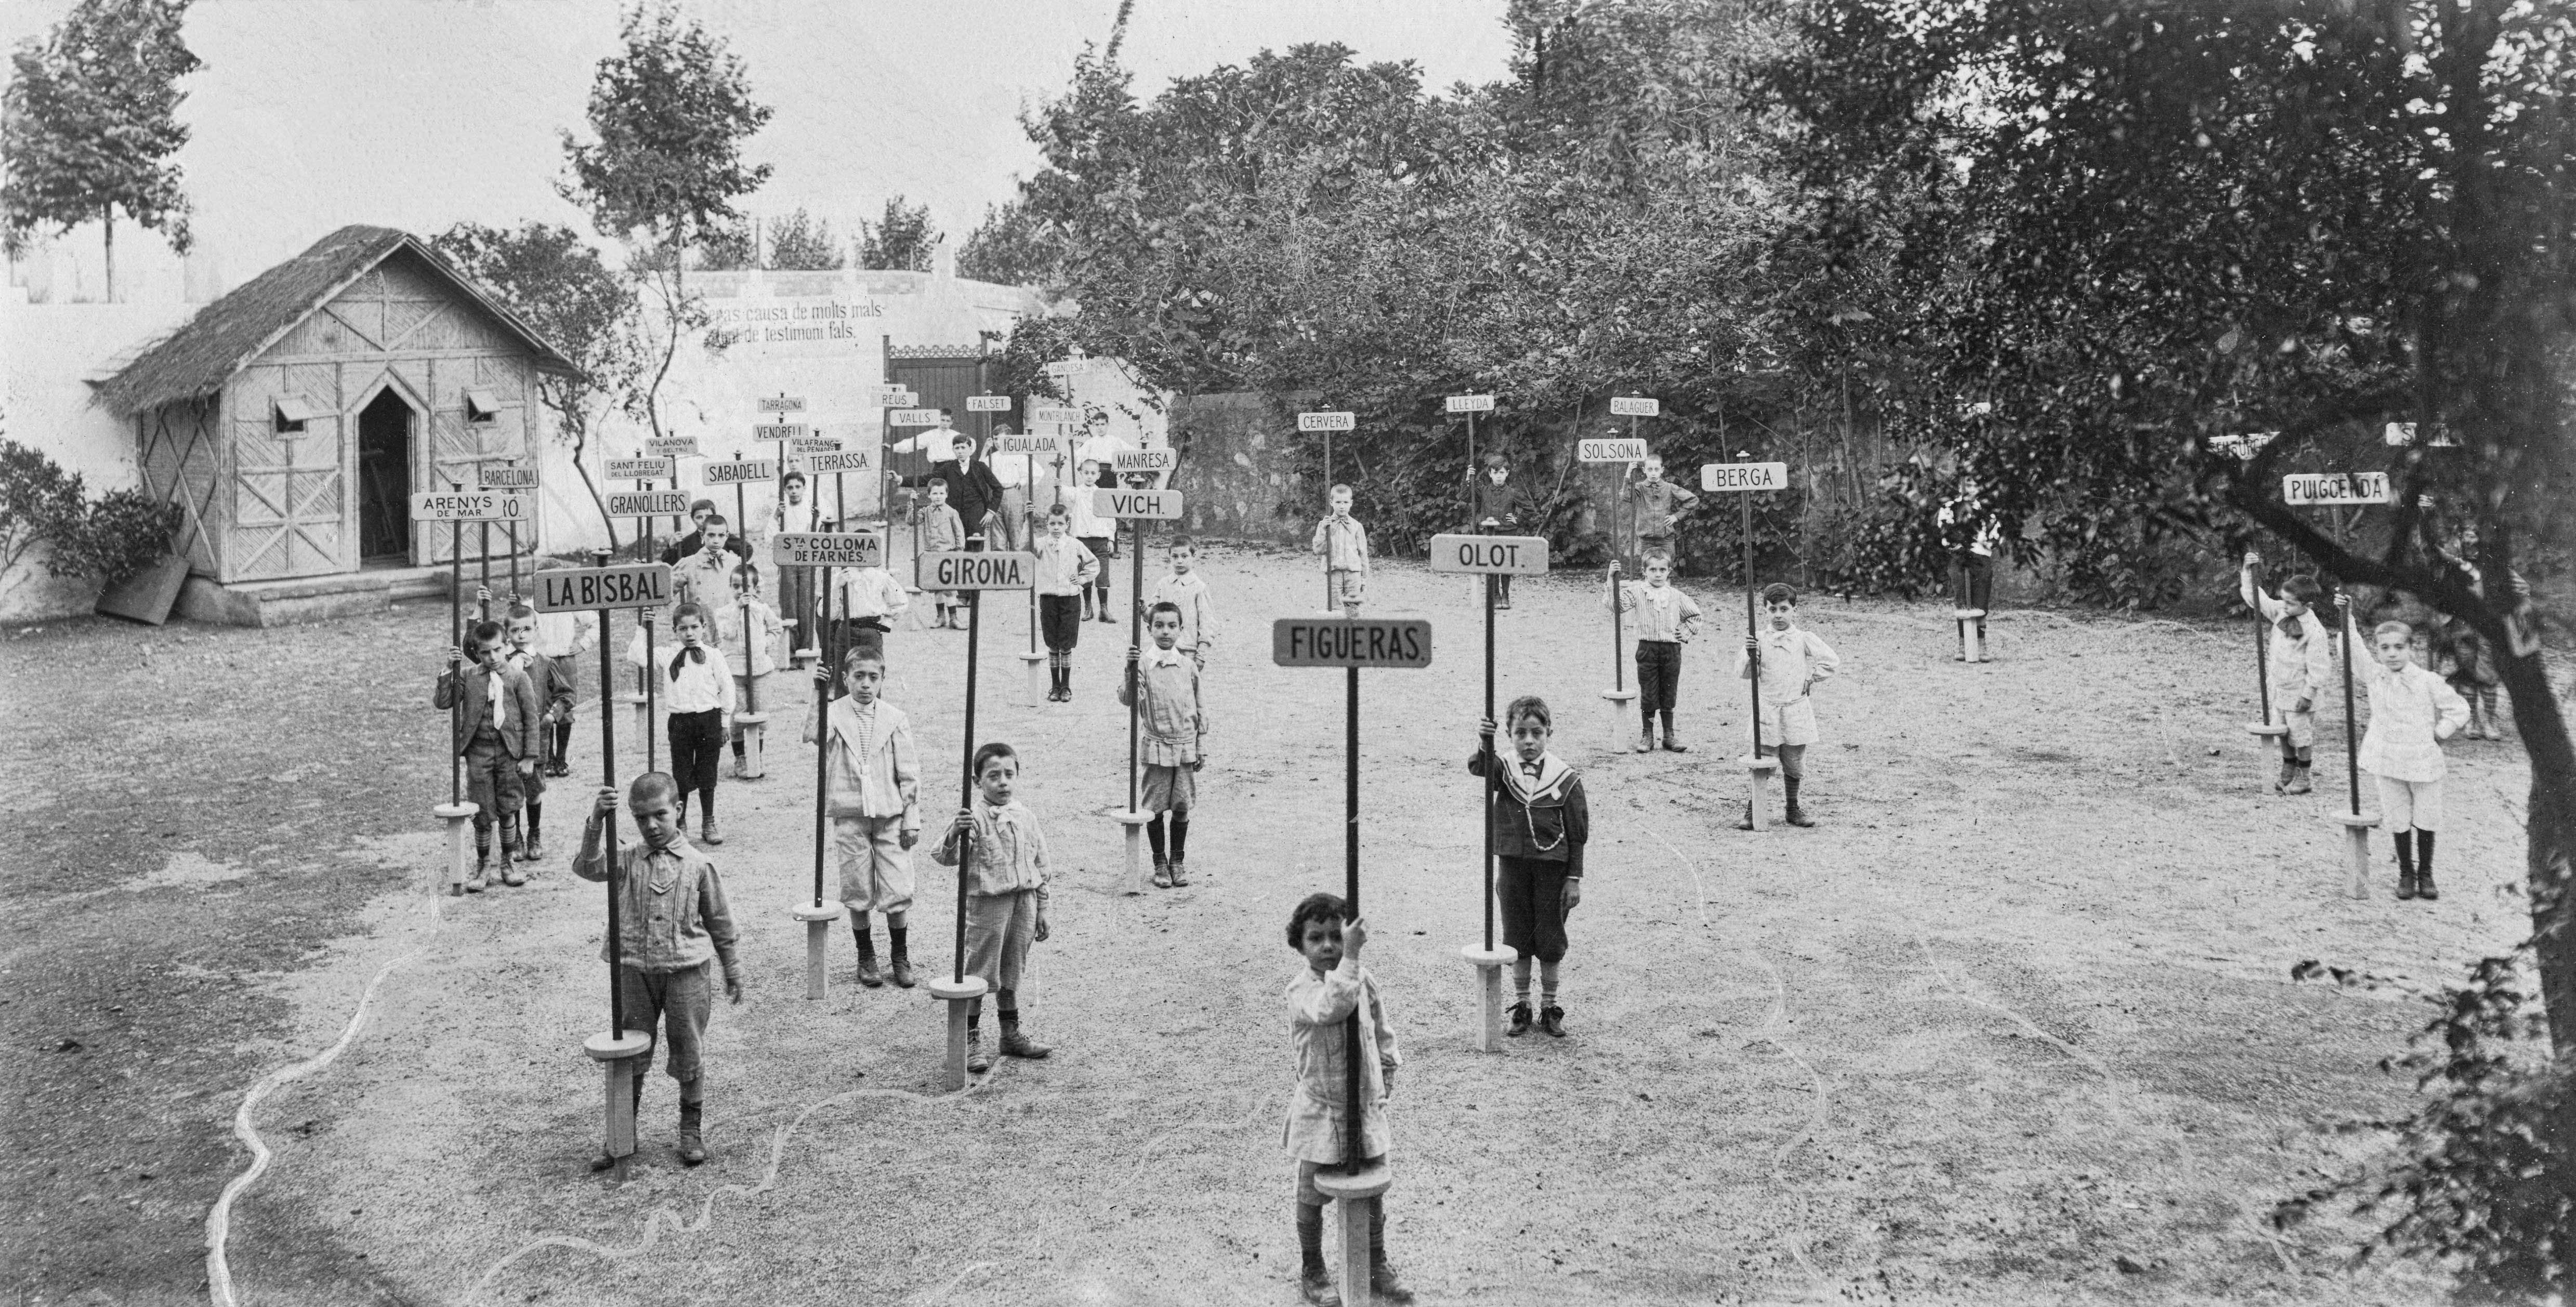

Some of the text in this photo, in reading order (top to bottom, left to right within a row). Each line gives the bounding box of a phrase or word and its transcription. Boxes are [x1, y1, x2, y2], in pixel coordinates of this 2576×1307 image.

[746, 308, 787, 321] causa
[793, 301, 807, 320] de
[812, 300, 846, 319] molts
[852, 299, 882, 318] mals
[745, 324, 759, 342] de
[765, 326, 823, 341] testimoni
[830, 321, 856, 338] fals.
[1052, 363, 1084, 373] GANDESA
[762, 400, 802, 411] TARRAGONA
[883, 394, 906, 405] REUS
[1453, 398, 1489, 410] LLEYDA
[1614, 401, 1655, 414] BALAGUER
[899, 413, 930, 423] VALLS
[1039, 410, 1080, 422] MONTBLANCH
[1303, 416, 1349, 429] CERVERA
[649, 439, 694, 447] VILANOVA
[792, 439, 836, 447] VILAFRANC
[1584, 443, 1642, 459] SOLSONA
[810, 453, 870, 471] TERRASSA.
[1117, 453, 1169, 469] MANRESA
[709, 463, 770, 482] SABADELL
[1717, 468, 1773, 487] BERGA
[424, 496, 492, 509] ARENYS
[611, 494, 688, 514] GRANOLLERS.
[1111, 495, 1165, 514] VICH.
[810, 537, 877, 550] COLOMA
[795, 549, 866, 562] DE FARNÉS.
[1459, 544, 1525, 568] OLOT.
[938, 558, 1025, 585] GIRONA.
[547, 572, 665, 606] LA BISBAL
[1291, 626, 1425, 663] FIGUERAS.
